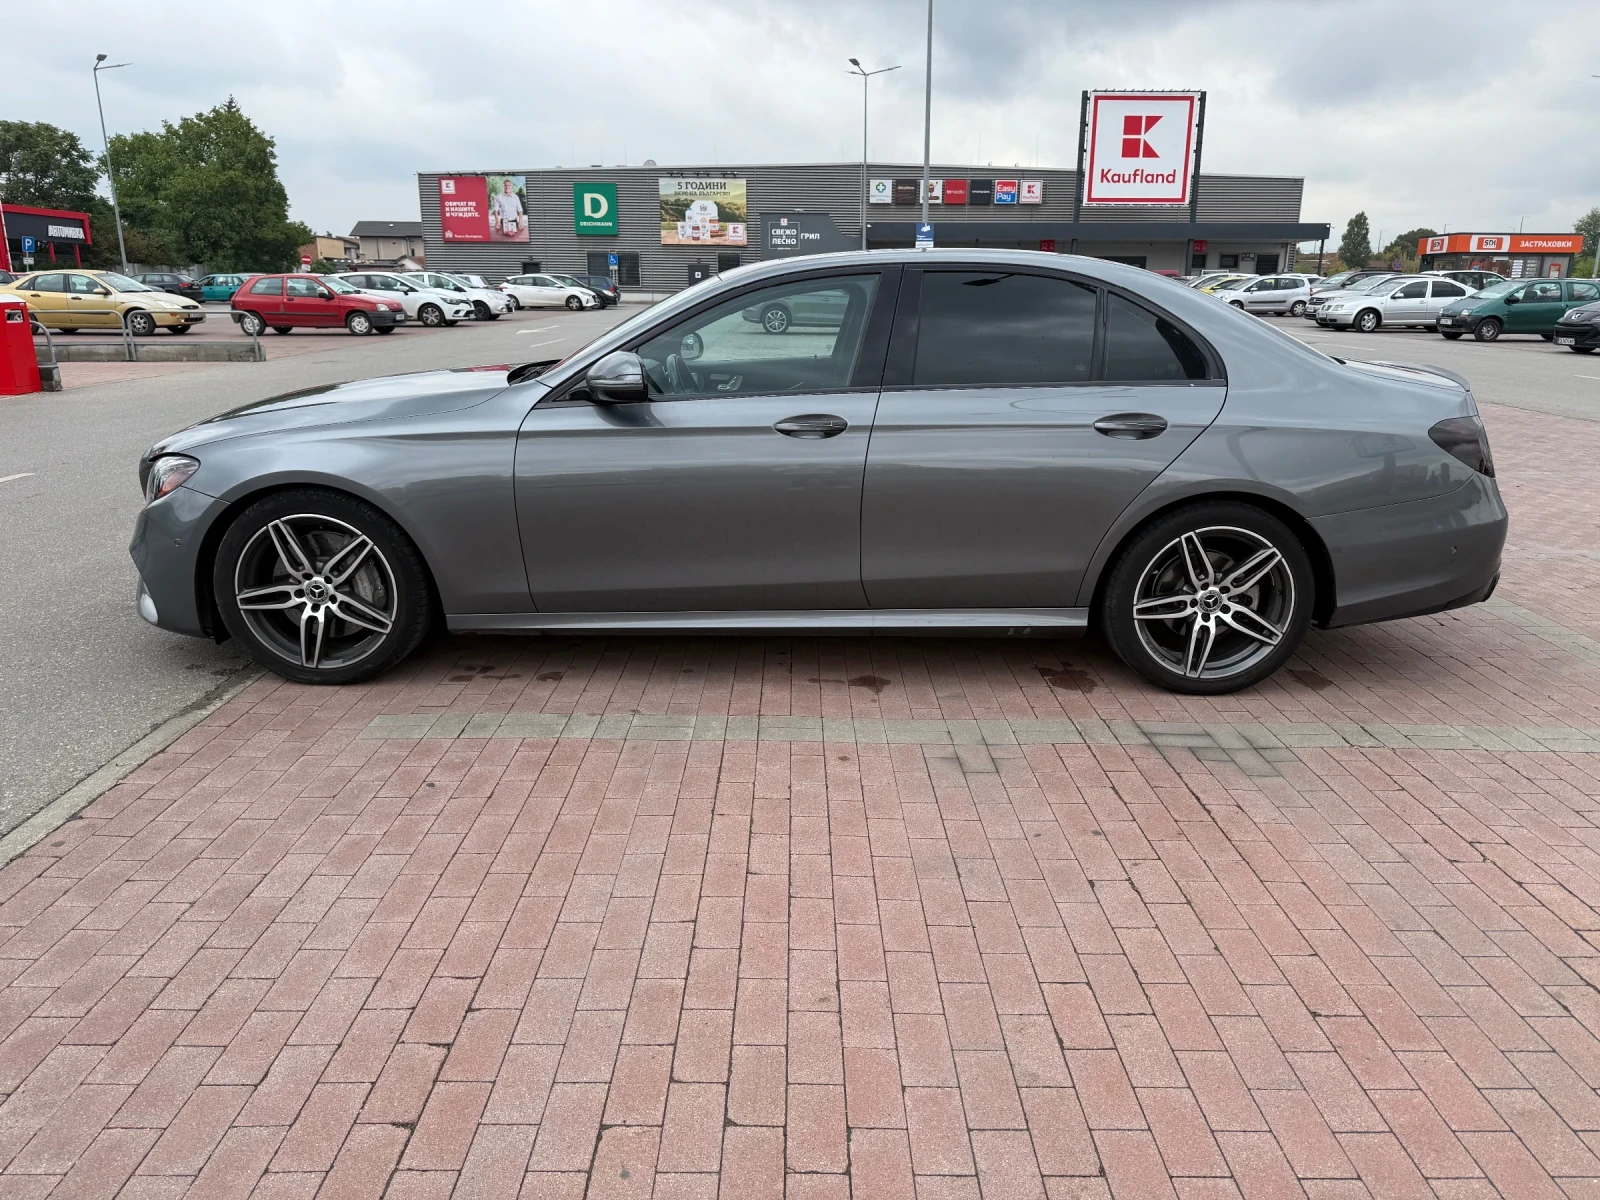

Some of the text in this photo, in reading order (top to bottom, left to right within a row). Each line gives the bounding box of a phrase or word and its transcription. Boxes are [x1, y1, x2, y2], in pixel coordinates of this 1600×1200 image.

[1100, 168, 1177, 184] Kaufland
[677, 181, 727, 191] 5 ГОДИНИ
[997, 184, 1016, 194] Easy
[996, 193, 1011, 201] Pay
[583, 193, 609, 219] D
[25, 238, 32, 250] P
[1484, 239, 1497, 247] SDI
[1519, 240, 1573, 248] ЗАСТРАХОВКИ
